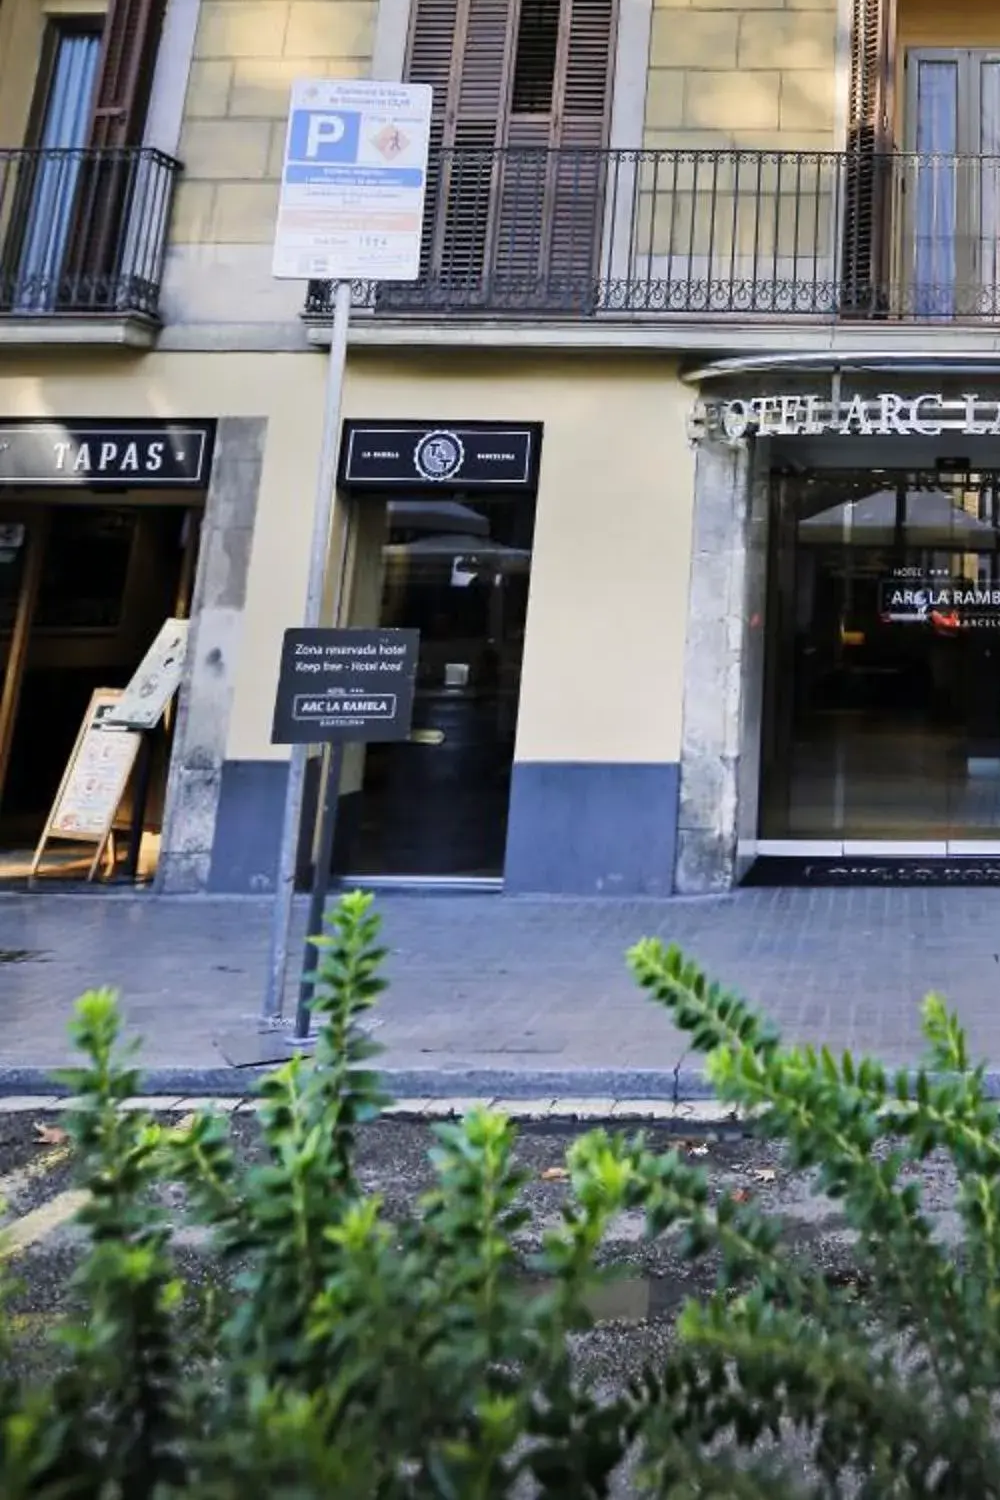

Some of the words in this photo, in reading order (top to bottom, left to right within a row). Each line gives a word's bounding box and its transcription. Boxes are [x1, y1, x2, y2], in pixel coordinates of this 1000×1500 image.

[305, 114, 345, 158] P
[839, 393, 942, 436] ARC
[54, 442, 165, 471] TAPAS
[891, 590, 927, 605] ARC
[929, 590, 949, 605] LA
[295, 643, 323, 655] Zona
[379, 643, 407, 655] hotel
[326, 701, 340, 712] LA
